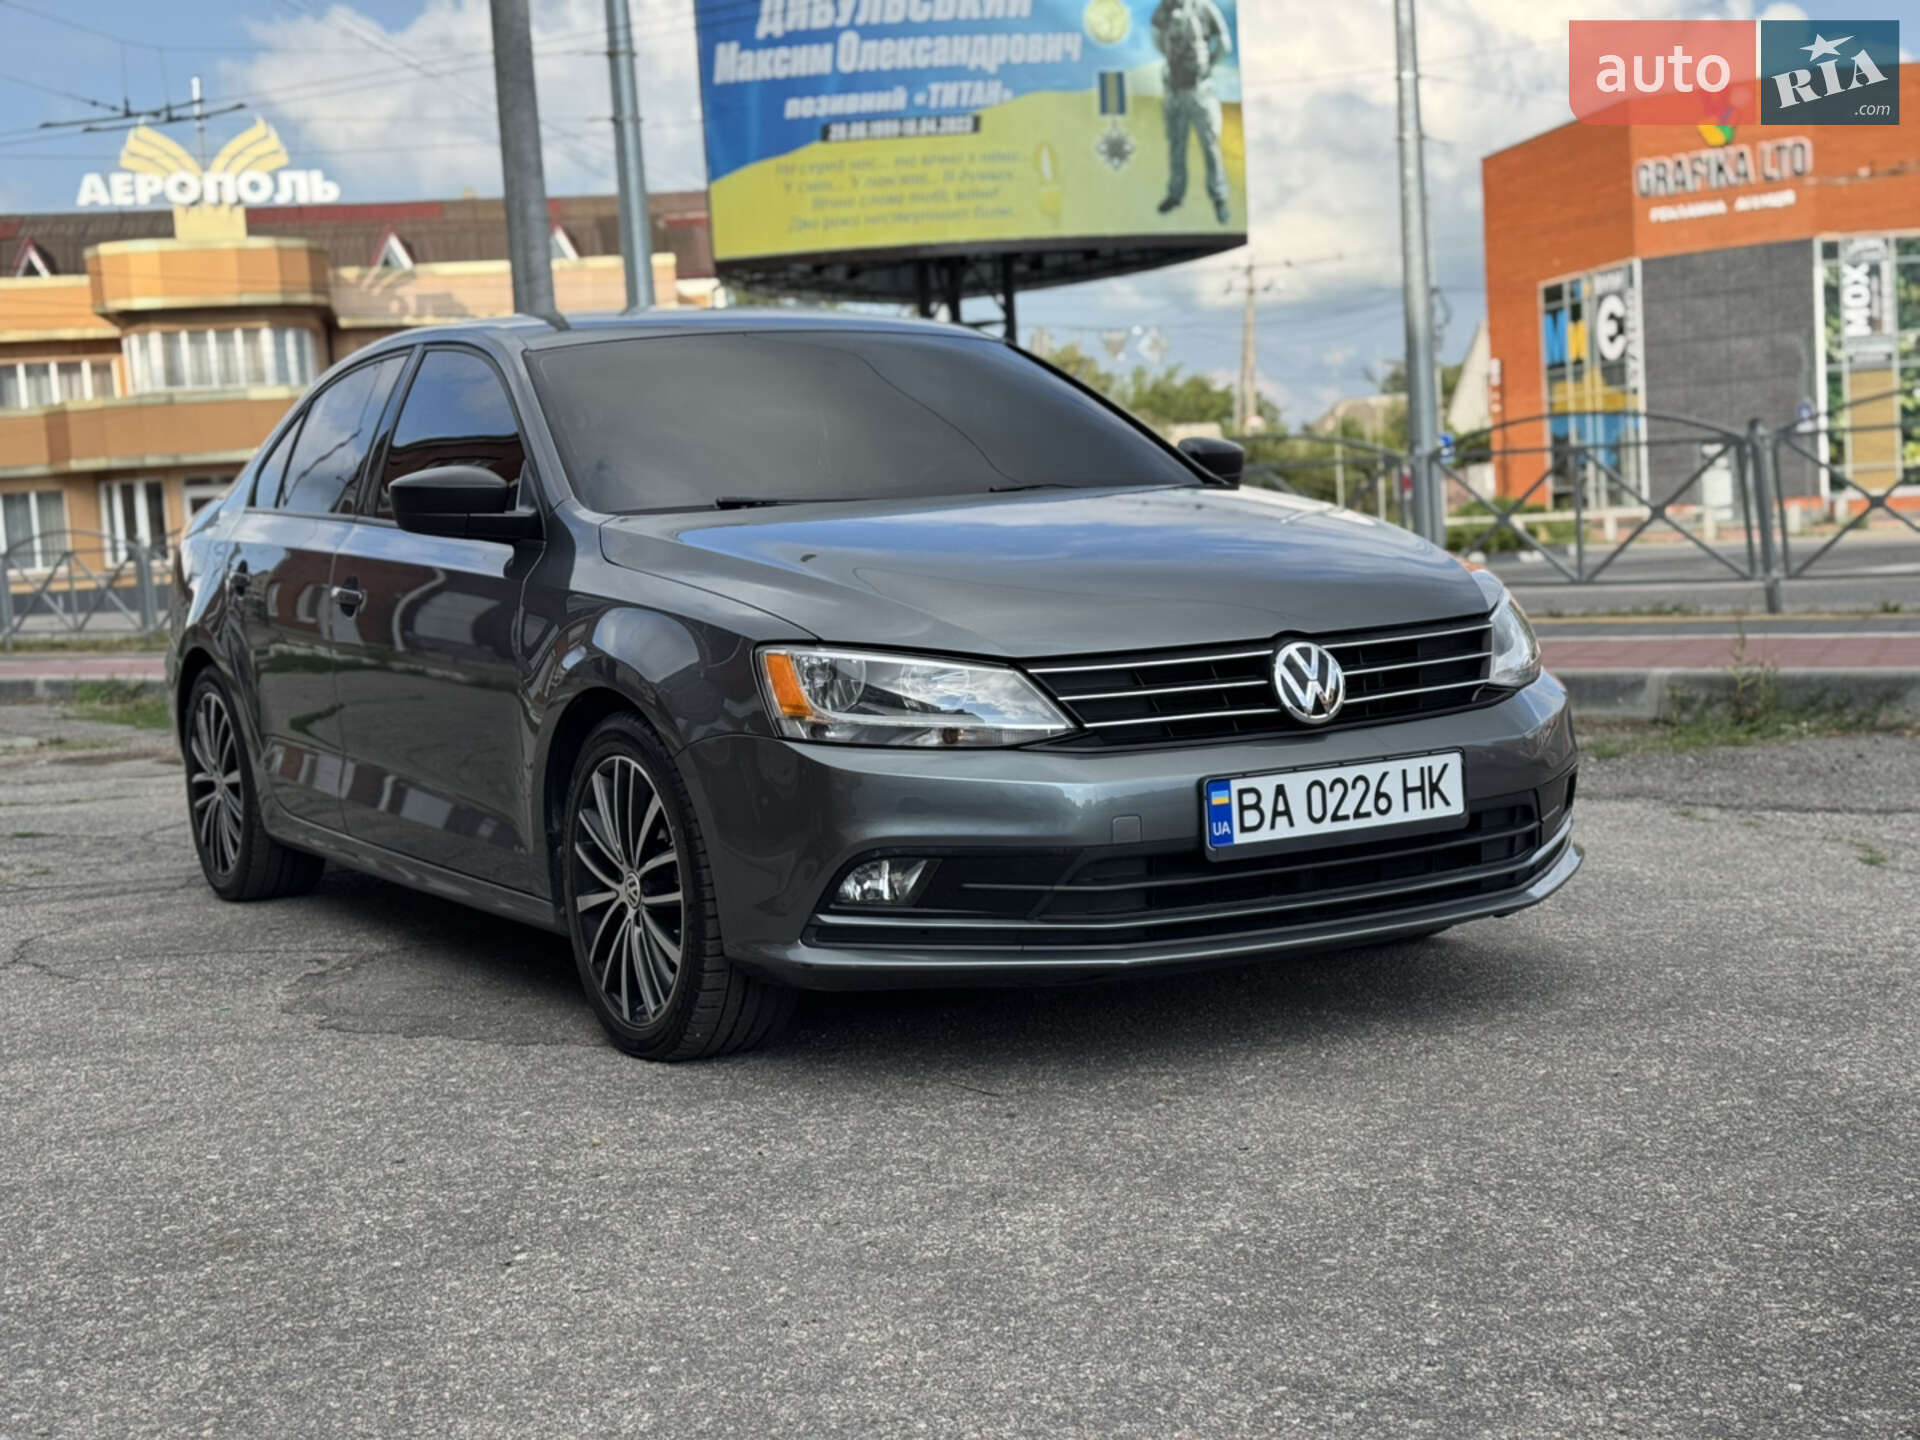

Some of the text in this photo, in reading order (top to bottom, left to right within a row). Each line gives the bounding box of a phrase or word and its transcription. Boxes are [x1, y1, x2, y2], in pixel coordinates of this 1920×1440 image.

[713, 30, 1082, 84] Максим Олександрович
[76, 169, 341, 207] АЕРОПОЛЬ
[1236, 763, 1452, 834] BA 0226 HK
[1212, 820, 1231, 836] UA
